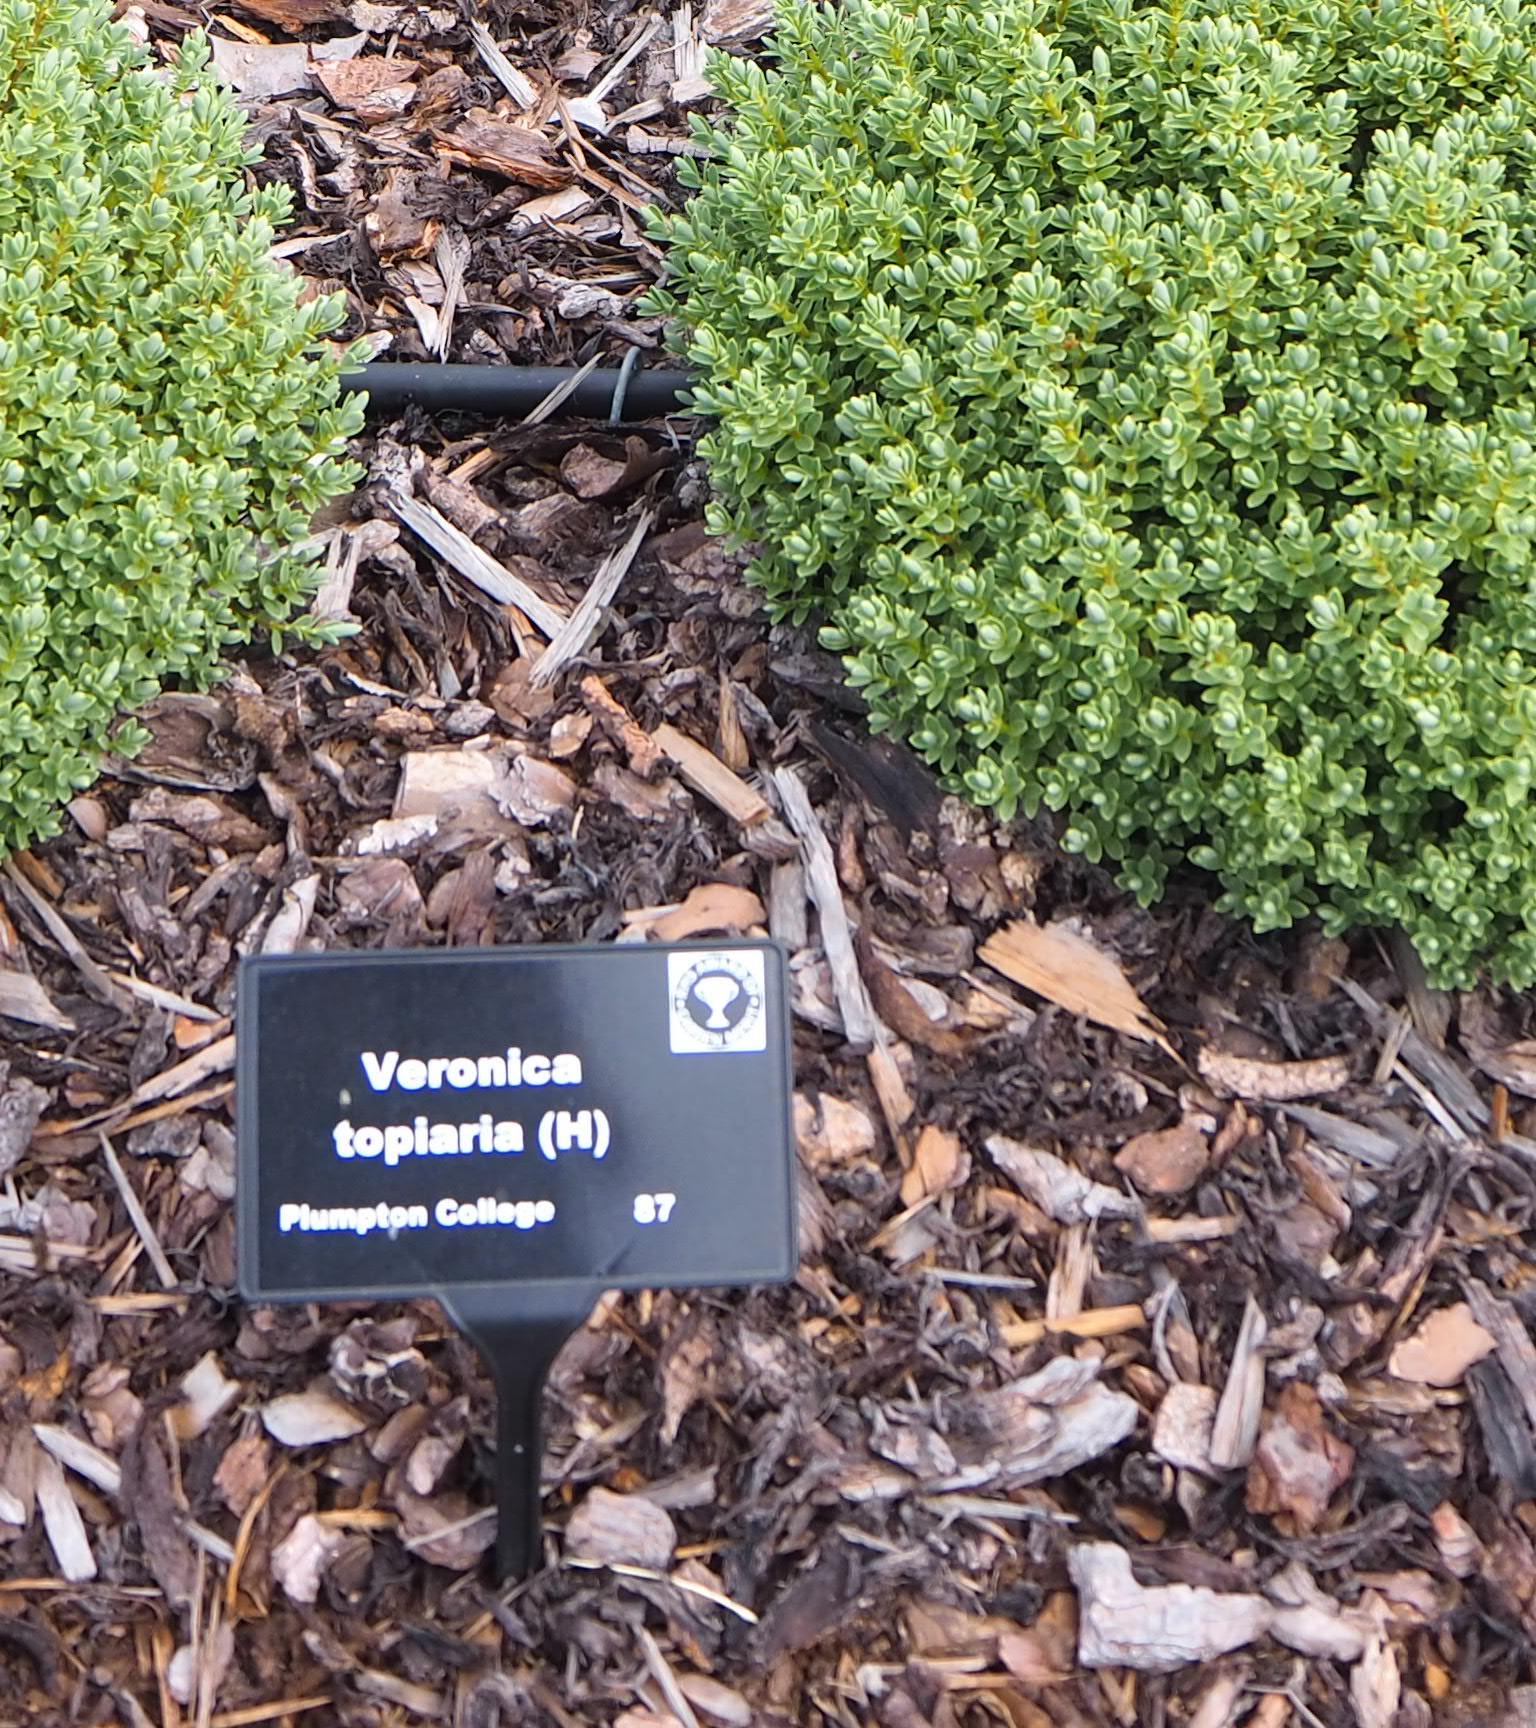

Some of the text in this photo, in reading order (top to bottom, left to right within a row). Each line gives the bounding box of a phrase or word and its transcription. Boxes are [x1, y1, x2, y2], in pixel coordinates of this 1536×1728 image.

[360, 1046, 583, 1091] Veronica
[332, 1108, 611, 1166] topiaria (H)
[278, 1192, 677, 1236] Plumpton College 87
